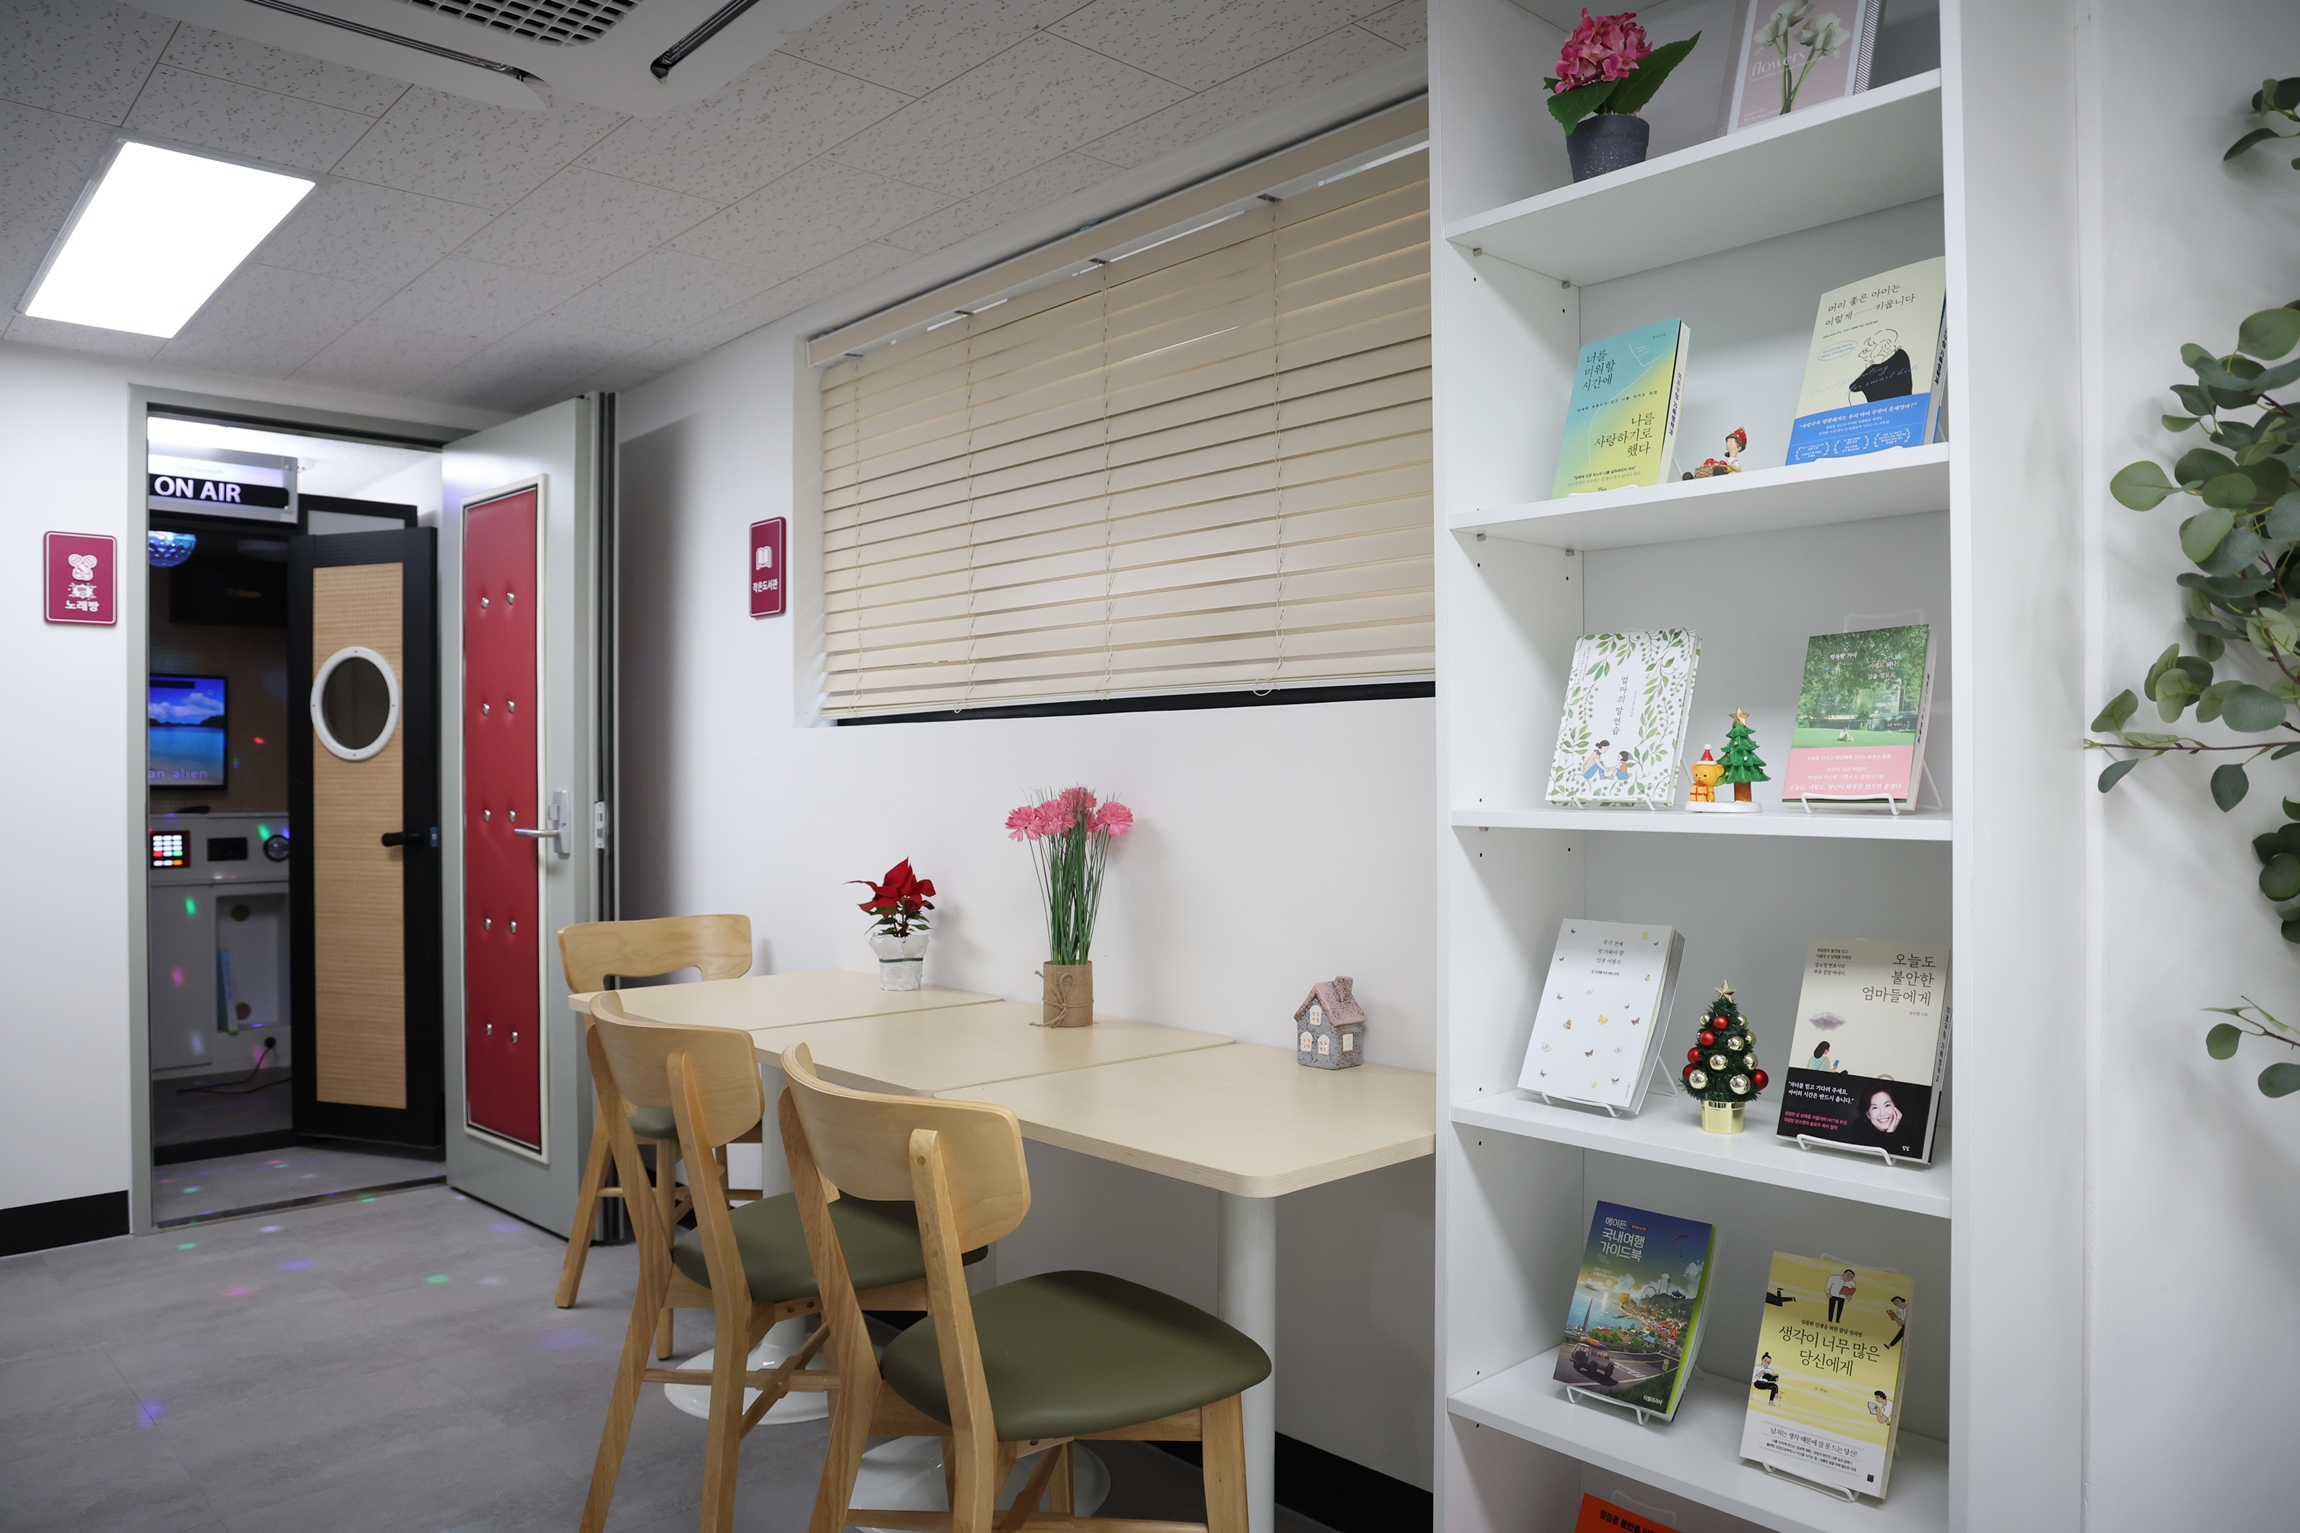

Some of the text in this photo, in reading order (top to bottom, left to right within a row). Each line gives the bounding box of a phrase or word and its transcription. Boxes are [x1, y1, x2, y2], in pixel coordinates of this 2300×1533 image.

[1752, 51, 1805, 76] flowers
[1828, 284, 1901, 312] 머리 좋은 아이는
[1825, 293, 1916, 326] 이렇게 키웁니다
[1586, 349, 1608, 364] 너를
[1584, 359, 1616, 377] 미워할
[1582, 373, 1613, 392] 시간에
[1631, 412, 1656, 426] 나를
[1594, 428, 1653, 448] 사랑하기로
[1627, 441, 1651, 458] 했다
[154, 476, 241, 503] ON AIR
[752, 578, 778, 592] 작은도서관
[64, 600, 100, 612] 노래방
[1612, 675, 1628, 736] 엄마의 말 연습
[172, 768, 208, 779] alien
[1808, 783, 1826, 791] 내일도,
[1892, 953, 1936, 968] 오늘도
[1891, 970, 1935, 988] 불안한
[1862, 986, 1932, 1006] 엄마들에게
[1803, 1091, 1818, 1099] 시간은
[1819, 1093, 1834, 1101] 반드시
[1605, 1216, 1628, 1230] 에이든
[1602, 1227, 1646, 1249] 국내여행
[1600, 1241, 1642, 1262] 가이드북
[1778, 1325, 1880, 1362] 생각이 너무 많은
[1800, 1350, 1854, 1376] 당신에게
[1788, 1432, 1800, 1441] 생각
[1801, 1436, 1818, 1446] 때문에
[1825, 1442, 1831, 1450] 못
[1831, 1445, 1844, 1454] 드는
